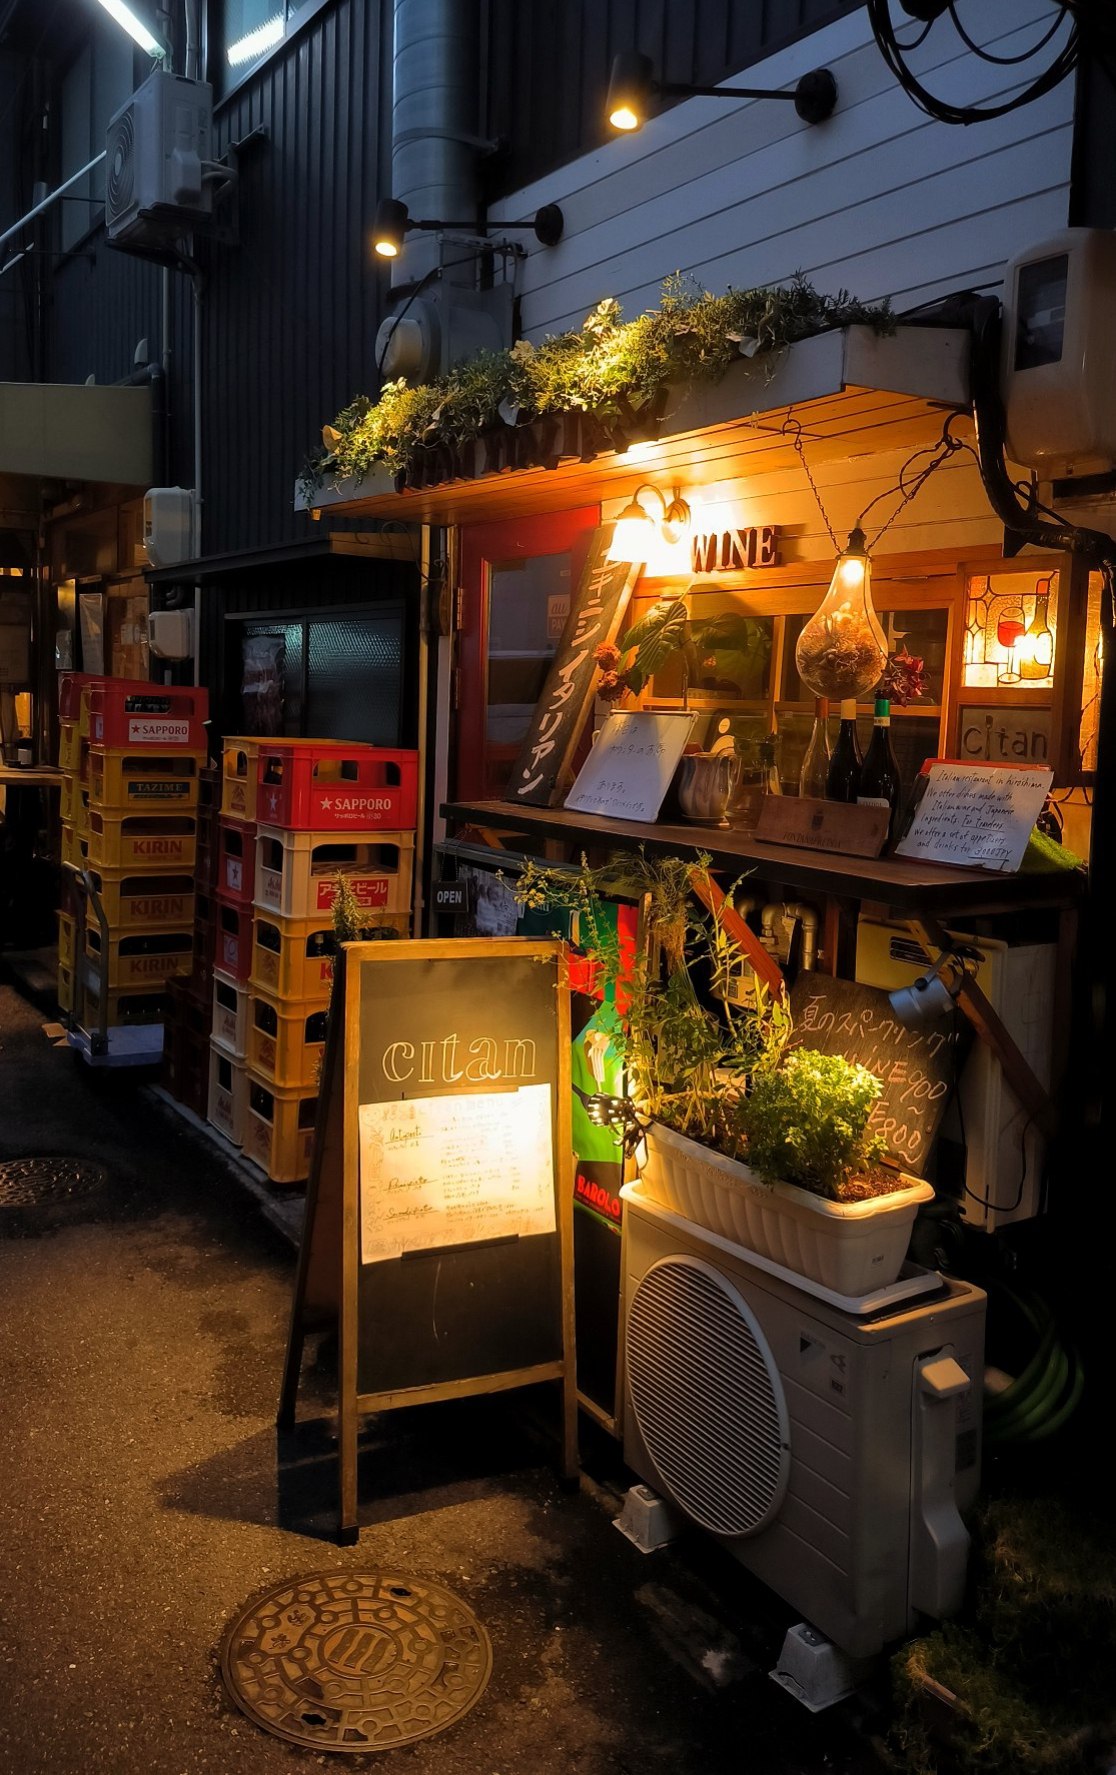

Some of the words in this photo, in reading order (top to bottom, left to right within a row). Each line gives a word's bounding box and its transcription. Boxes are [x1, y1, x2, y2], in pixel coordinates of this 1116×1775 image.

[691, 526, 775, 573] WINE
[142, 725, 188, 735] SAPPORO
[963, 715, 1048, 760] citan
[936, 769, 960, 783] Italian
[995, 775, 1004, 785] in
[926, 786, 937, 798] We
[979, 789, 996, 801] made
[996, 791, 1013, 802] with
[334, 798, 392, 810] SAPPORO
[931, 799, 954, 811] Italian
[970, 803, 985, 813] and
[133, 839, 183, 855] KIRIN
[916, 836, 931, 848] and
[436, 890, 462, 904] OPEN
[130, 898, 184, 916] KIRIN
[129, 957, 180, 973] KIRIN
[874, 1118, 922, 1148] 800
[577, 1174, 620, 1217] BAROLO
